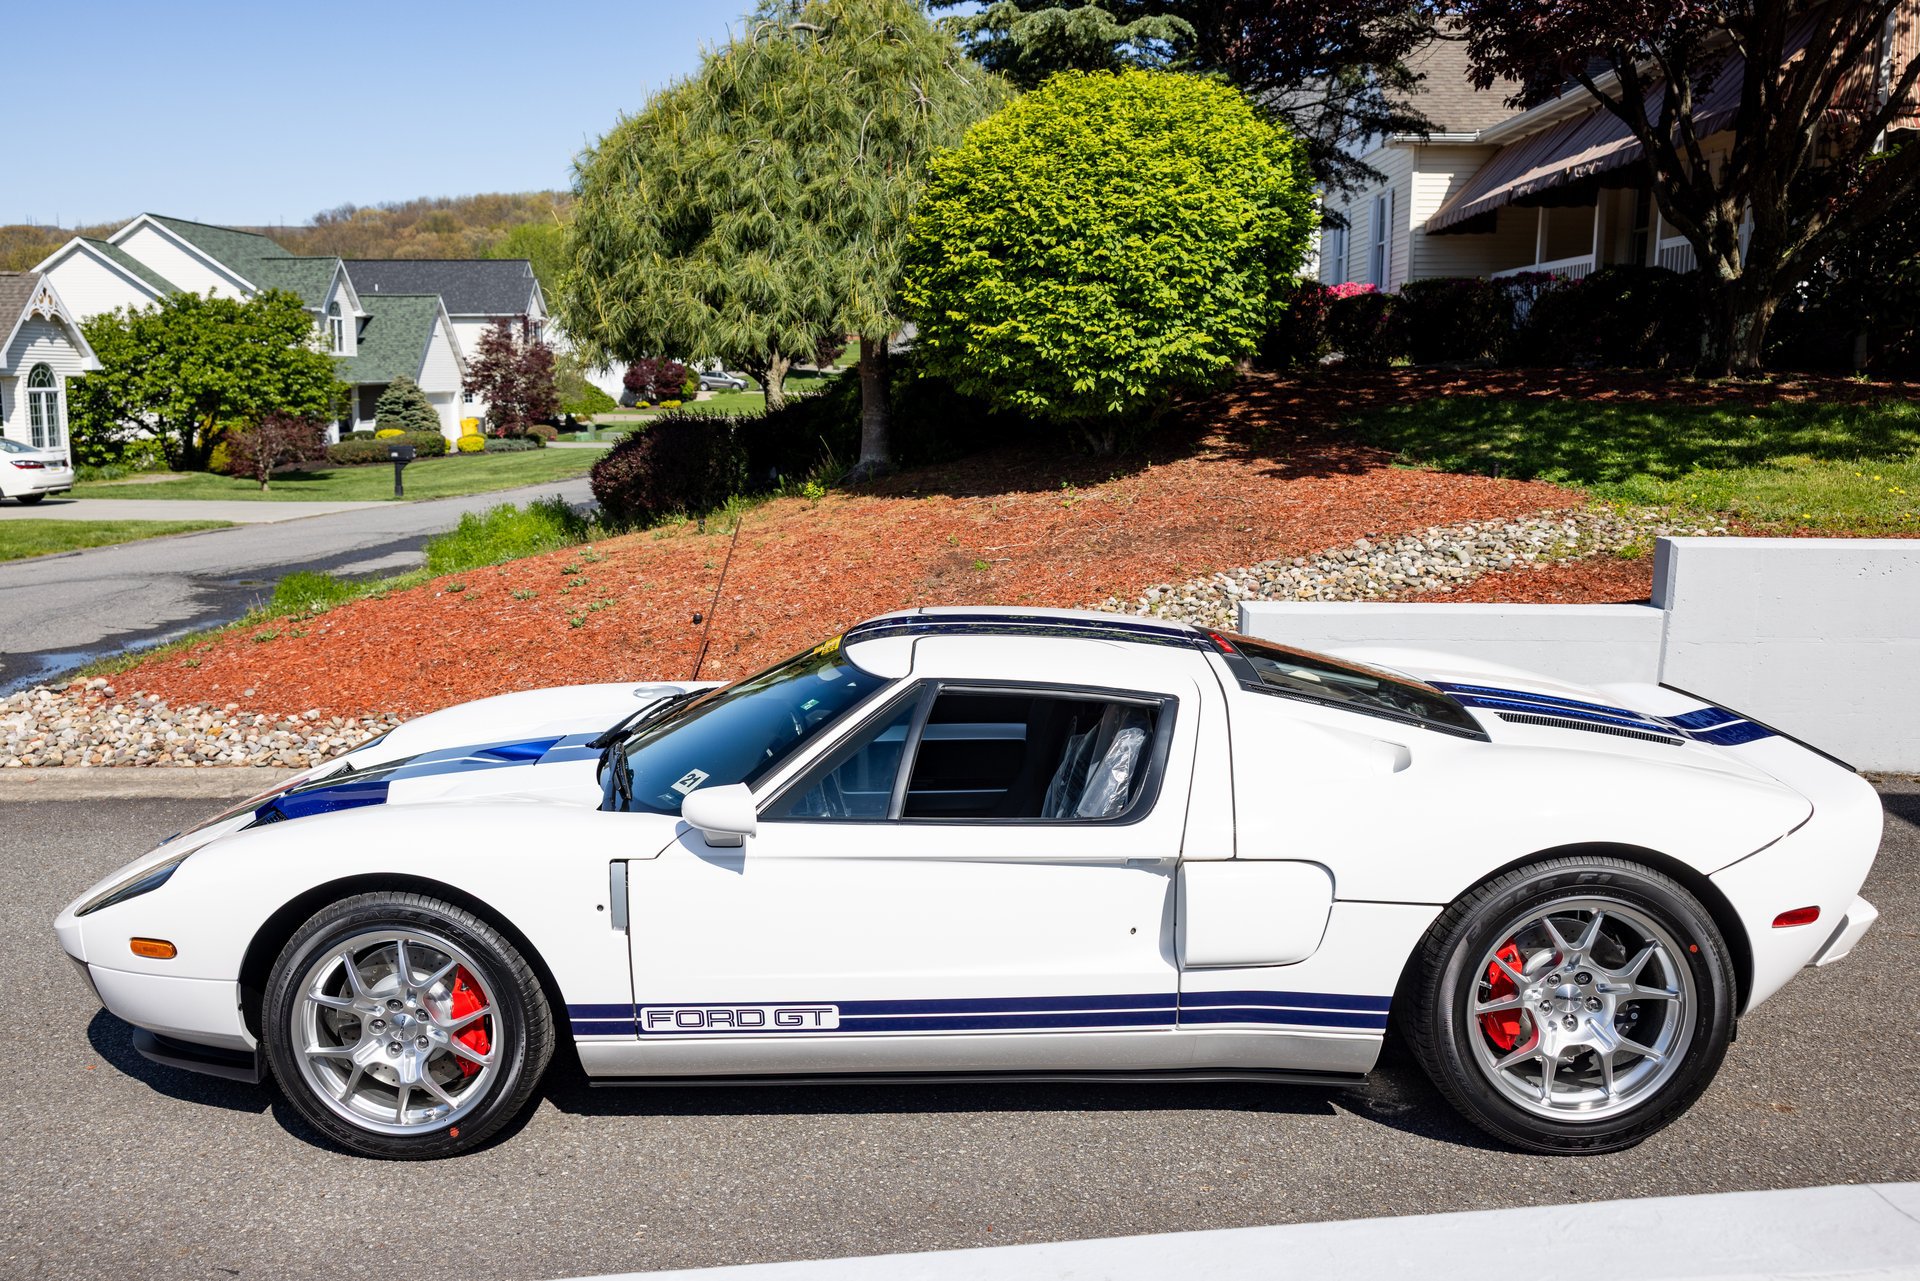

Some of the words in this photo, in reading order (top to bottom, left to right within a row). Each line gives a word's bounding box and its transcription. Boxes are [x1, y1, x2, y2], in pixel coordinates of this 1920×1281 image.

[679, 774, 701, 787] 21
[647, 1009, 766, 1028] FORD
[774, 1008, 833, 1026] GT
